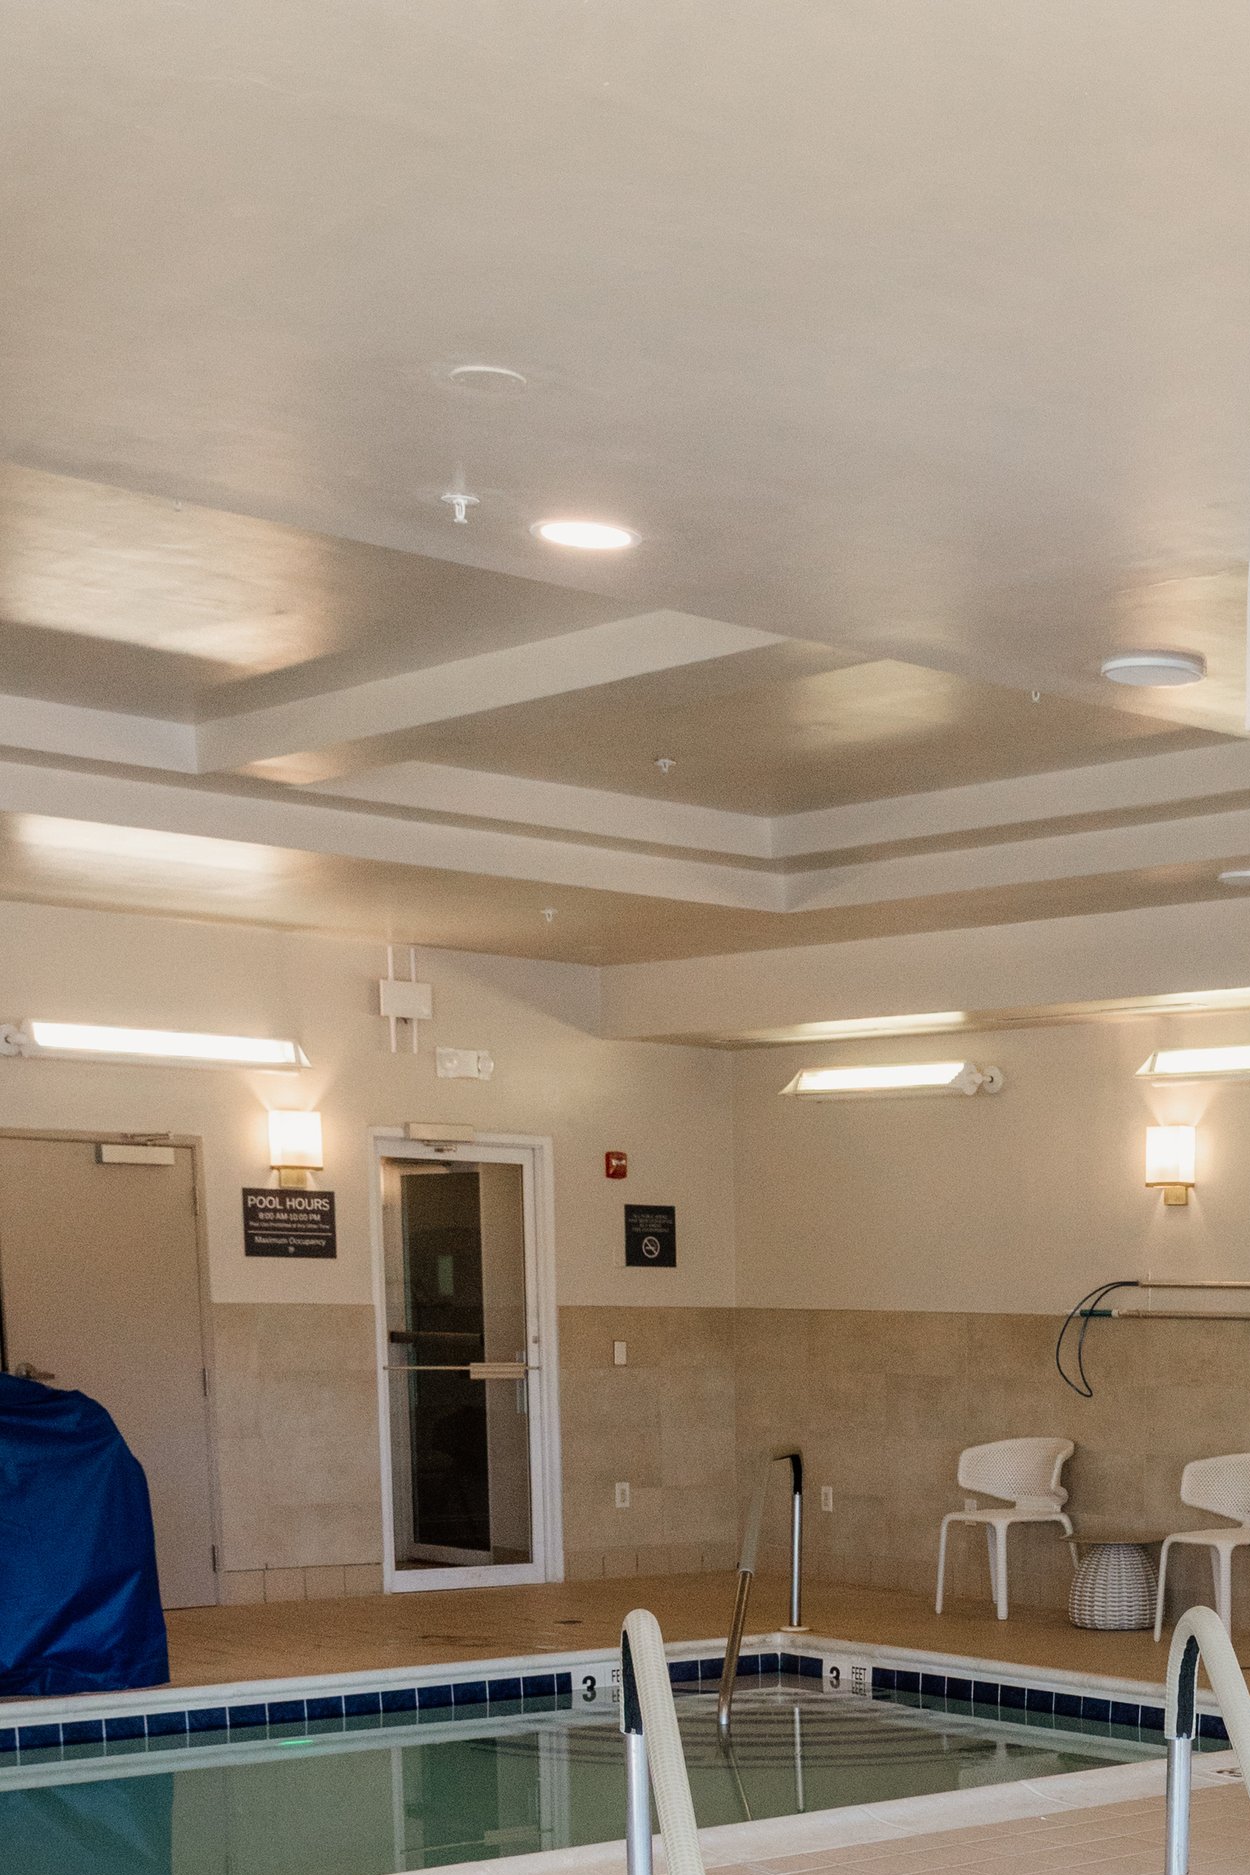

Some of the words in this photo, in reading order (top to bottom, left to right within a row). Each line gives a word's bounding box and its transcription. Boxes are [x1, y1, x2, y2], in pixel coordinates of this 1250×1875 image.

[247, 1196, 284, 1209] POOL
[286, 1198, 330, 1211] HOURS
[829, 1666, 841, 1681] 3
[851, 1666, 867, 1681] FEET
[582, 1675, 596, 1691] 3
